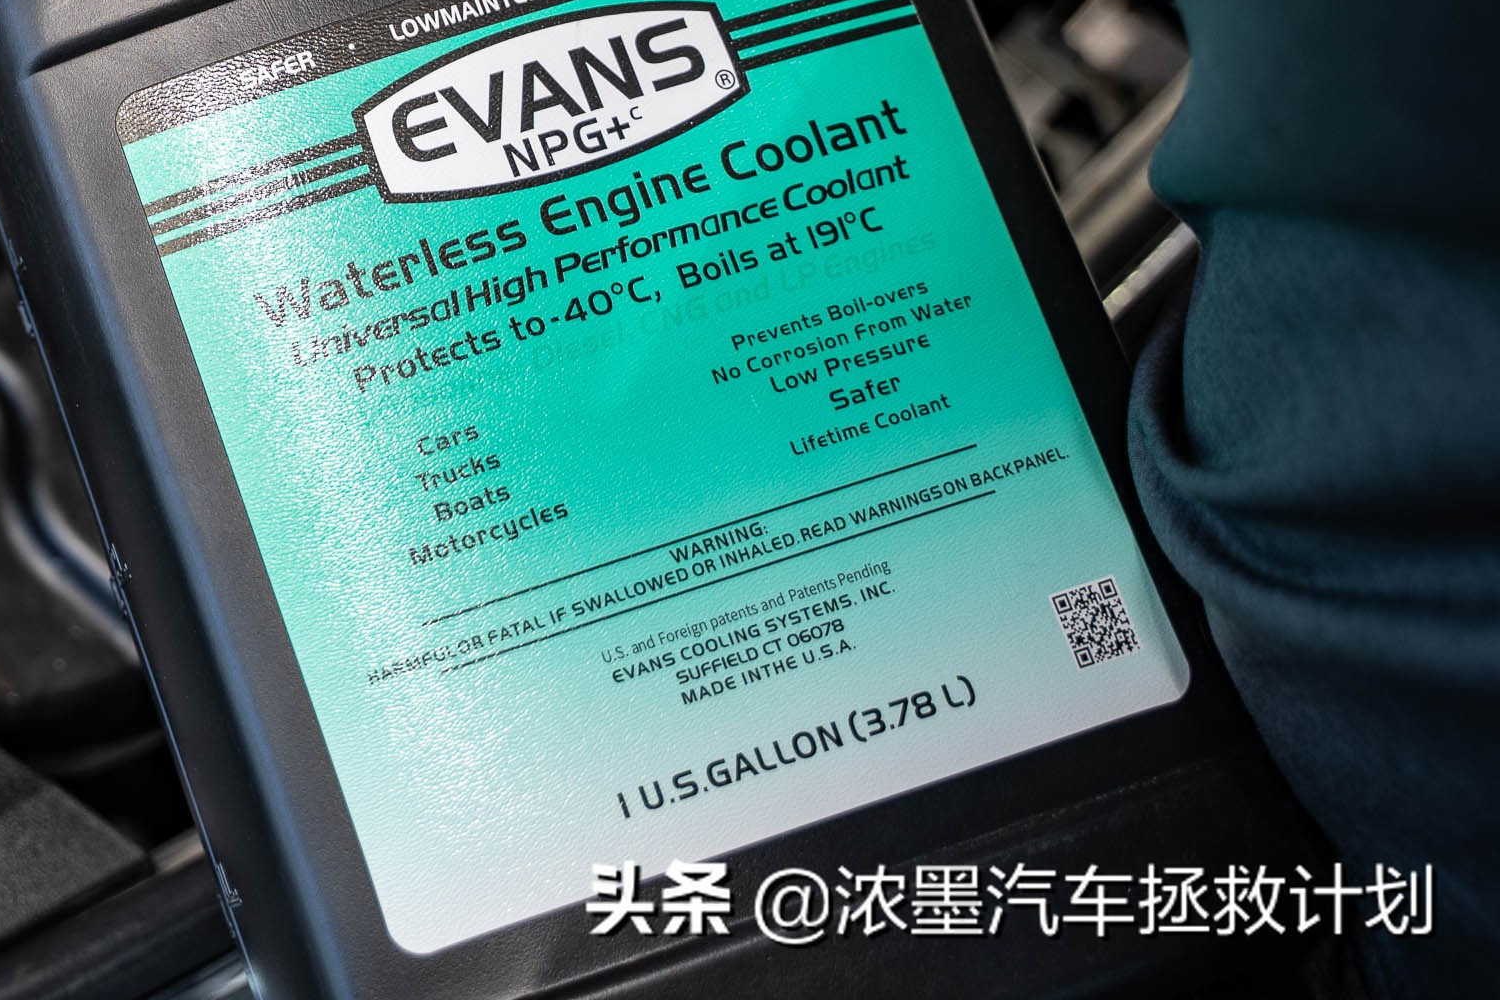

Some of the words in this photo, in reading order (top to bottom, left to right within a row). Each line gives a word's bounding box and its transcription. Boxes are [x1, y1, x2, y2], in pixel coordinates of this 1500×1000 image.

[240, 51, 316, 87] SAFER
[391, 17, 706, 163] EVANS
[253, 219, 527, 328] Waterless
[541, 162, 711, 235] Engine
[721, 99, 907, 181] Coolant
[782, 154, 910, 211] Coolant
[352, 329, 501, 393] Protects
[676, 248, 758, 289] Boils
[769, 231, 802, 262] at
[806, 206, 883, 250] 191°C
[730, 313, 823, 350] Prevents
[826, 281, 929, 322] Boil-overs
[711, 366, 741, 385] No
[746, 332, 850, 373] Corrosion
[854, 315, 908, 341] From
[910, 294, 973, 323] Water
[769, 367, 819, 393] Low
[823, 334, 931, 378] Pressure
[789, 421, 871, 456] Lifetime
[874, 393, 951, 429] Coolant
[828, 376, 901, 411] Safer
[415, 454, 501, 491] Trucks
[416, 424, 480, 456] Cars
[409, 502, 569, 566] Motorcycles
[433, 485, 511, 522] Boats
[669, 521, 769, 563] WARNING:
[487, 614, 546, 646] FATAL
[549, 606, 567, 626] IF
[572, 569, 690, 618] SWALLOWED
[691, 557, 717, 577] OR
[600, 649, 629, 665] U.S.
[632, 637, 656, 656] and
[657, 621, 708, 648] Foreign
[709, 604, 759, 633] patents
[761, 593, 786, 612] and
[787, 579, 837, 603] Patents
[837, 560, 892, 587] Pending
[612, 652, 676, 684] EVANS
[680, 623, 761, 661] COOLING
[860, 580, 896, 603] INC.
[675, 646, 759, 685] SUFFIELD
[762, 638, 783, 656] CT
[786, 618, 845, 648] 06078
[680, 676, 738, 706] MADE
[802, 637, 857, 665] U.S.A.
[847, 690, 938, 743] (3.78
[940, 675, 977, 710] L)
